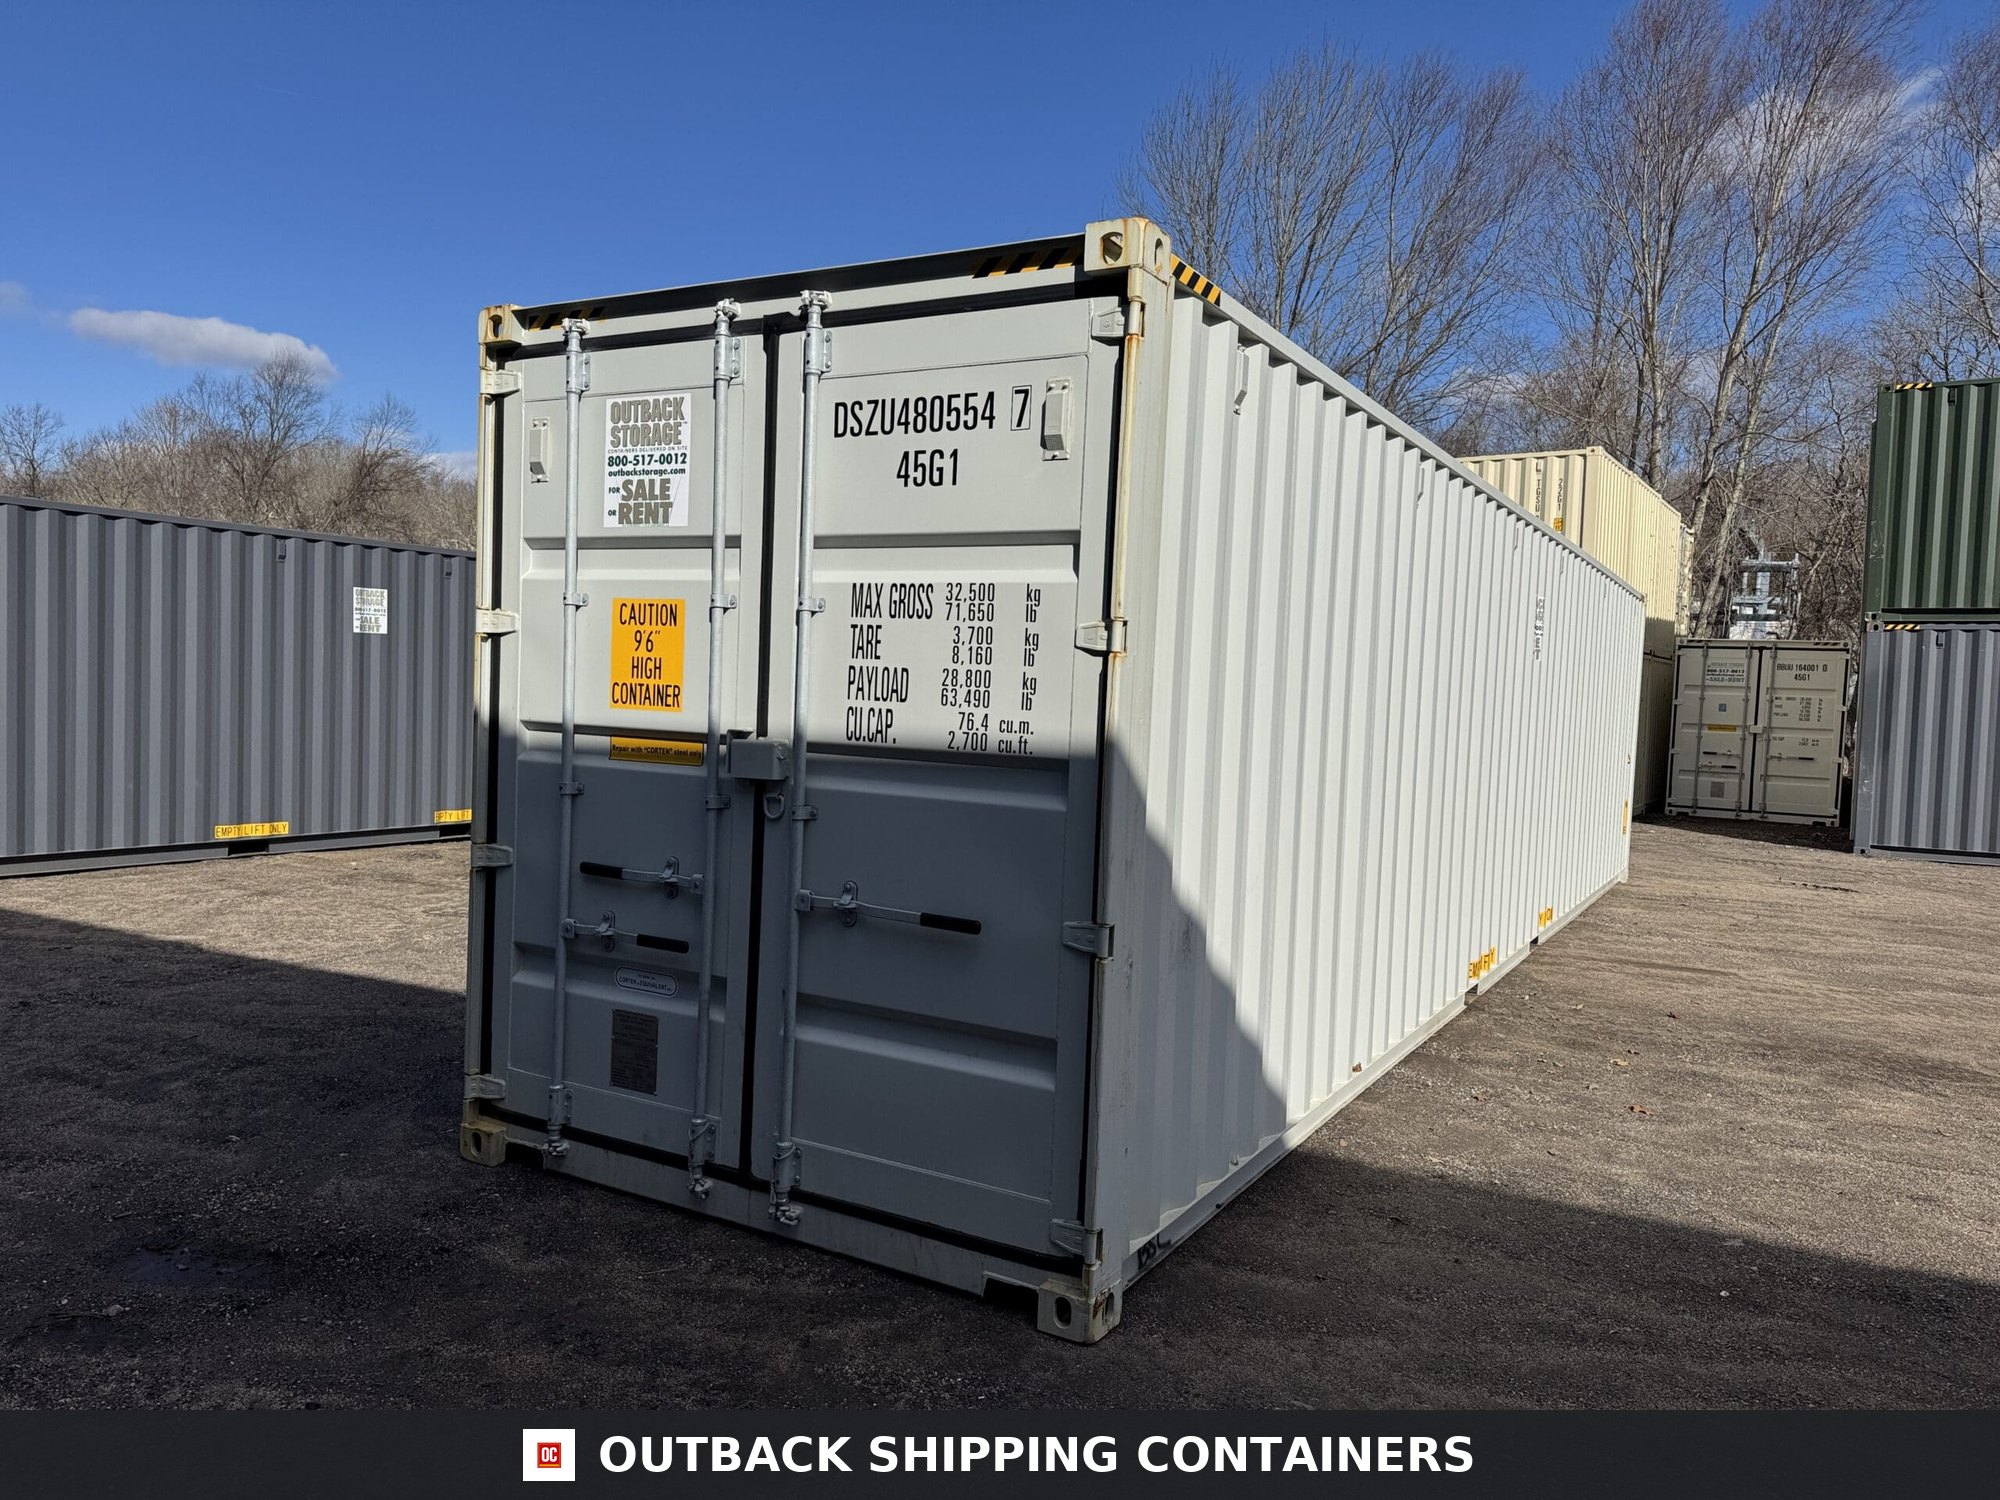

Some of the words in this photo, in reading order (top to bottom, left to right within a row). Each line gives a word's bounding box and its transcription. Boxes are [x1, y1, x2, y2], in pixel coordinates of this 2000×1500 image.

[610, 396, 685, 424] OUTBACK
[834, 391, 996, 438] DSZU480554
[1014, 389, 1030, 428] 7
[610, 421, 683, 448] STORAGE
[607, 452, 688, 467] 800-517-0012
[896, 448, 958, 487] 45G1
[608, 467, 686, 477] outbackstorage.com
[621, 478, 671, 501] SALE
[618, 502, 673, 525] RENT
[850, 583, 884, 618] MAX
[888, 583, 934, 619] GROSS
[945, 582, 995, 602] 32,500
[1026, 583, 1041, 607] kg
[945, 602, 995, 622] 71,650
[1025, 603, 1037, 623] lb
[619, 603, 677, 627] CAUTION
[850, 624, 882, 660] TARE
[953, 625, 993, 646] 3,700
[1025, 627, 1039, 651] kg
[631, 656, 662, 680] HIGH
[952, 645, 993, 666] 8,160
[1024, 648, 1035, 667] lb
[611, 682, 681, 708] CONTAINER
[847, 665, 909, 703] PAYLOAD
[942, 668, 991, 689] 28,800
[1022, 672, 1037, 695] kg
[940, 688, 990, 708] 63,490
[1021, 692, 1032, 711] lb
[845, 706, 897, 744] CU.CAP.
[958, 712, 989, 732] 76.4
[999, 719, 1034, 735] cu.m.
[612, 744, 630, 753] Repair
[644, 747, 673, 755] "CORTEN"
[689, 750, 701, 758] only
[947, 731, 988, 751] 2,700
[998, 736, 1033, 755] cu.ft.
[215, 826, 241, 837] EMPTY
[244, 825, 265, 835] LIFT
[269, 823, 287, 833] ONLY
